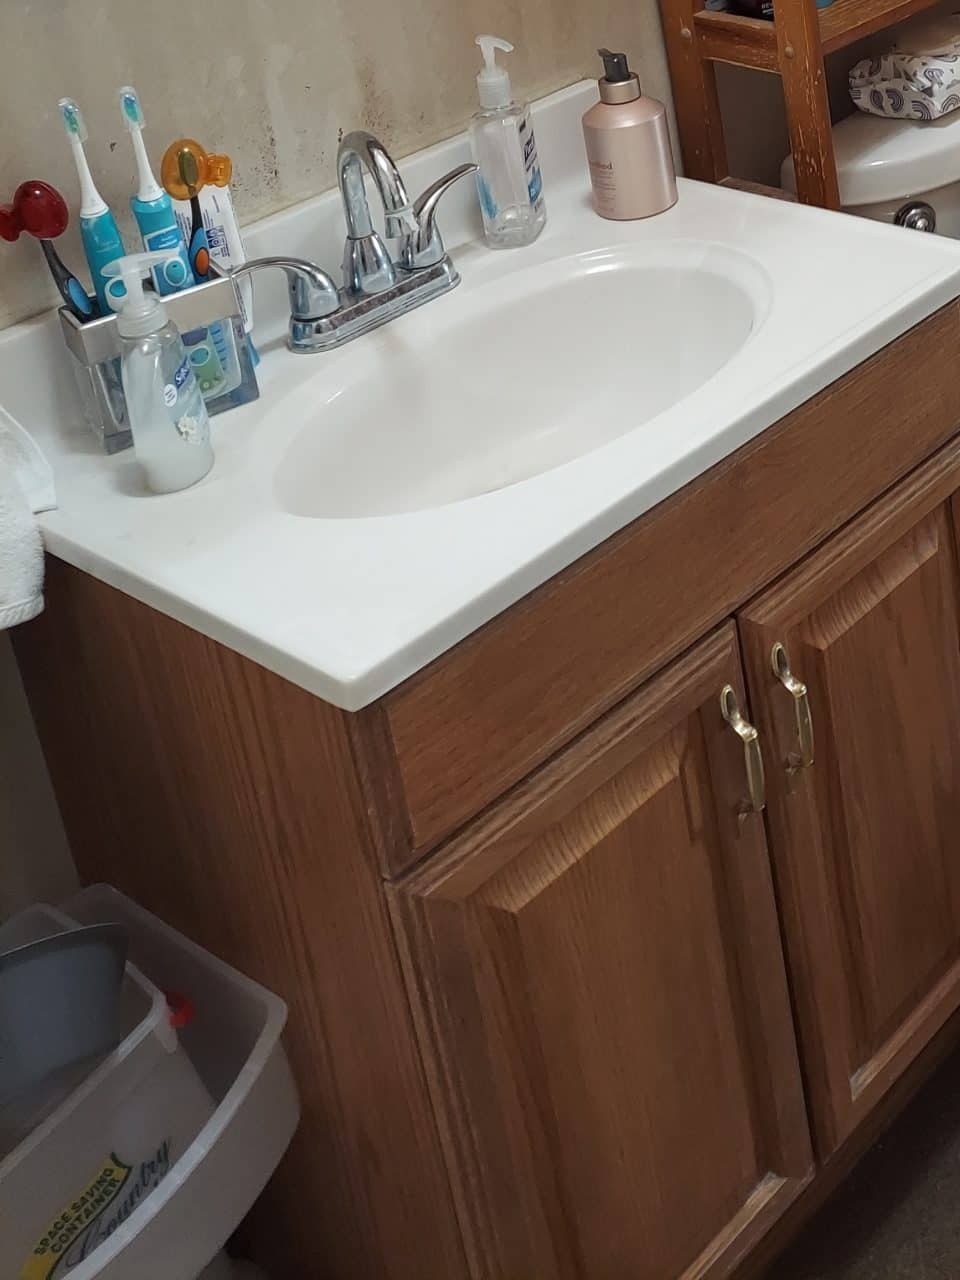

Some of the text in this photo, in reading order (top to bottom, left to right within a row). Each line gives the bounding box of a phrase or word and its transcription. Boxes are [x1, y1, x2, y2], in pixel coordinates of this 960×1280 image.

[33, 1167, 115, 1256] SPACE SAVING
[50, 1176, 121, 1254] CONTAINER
